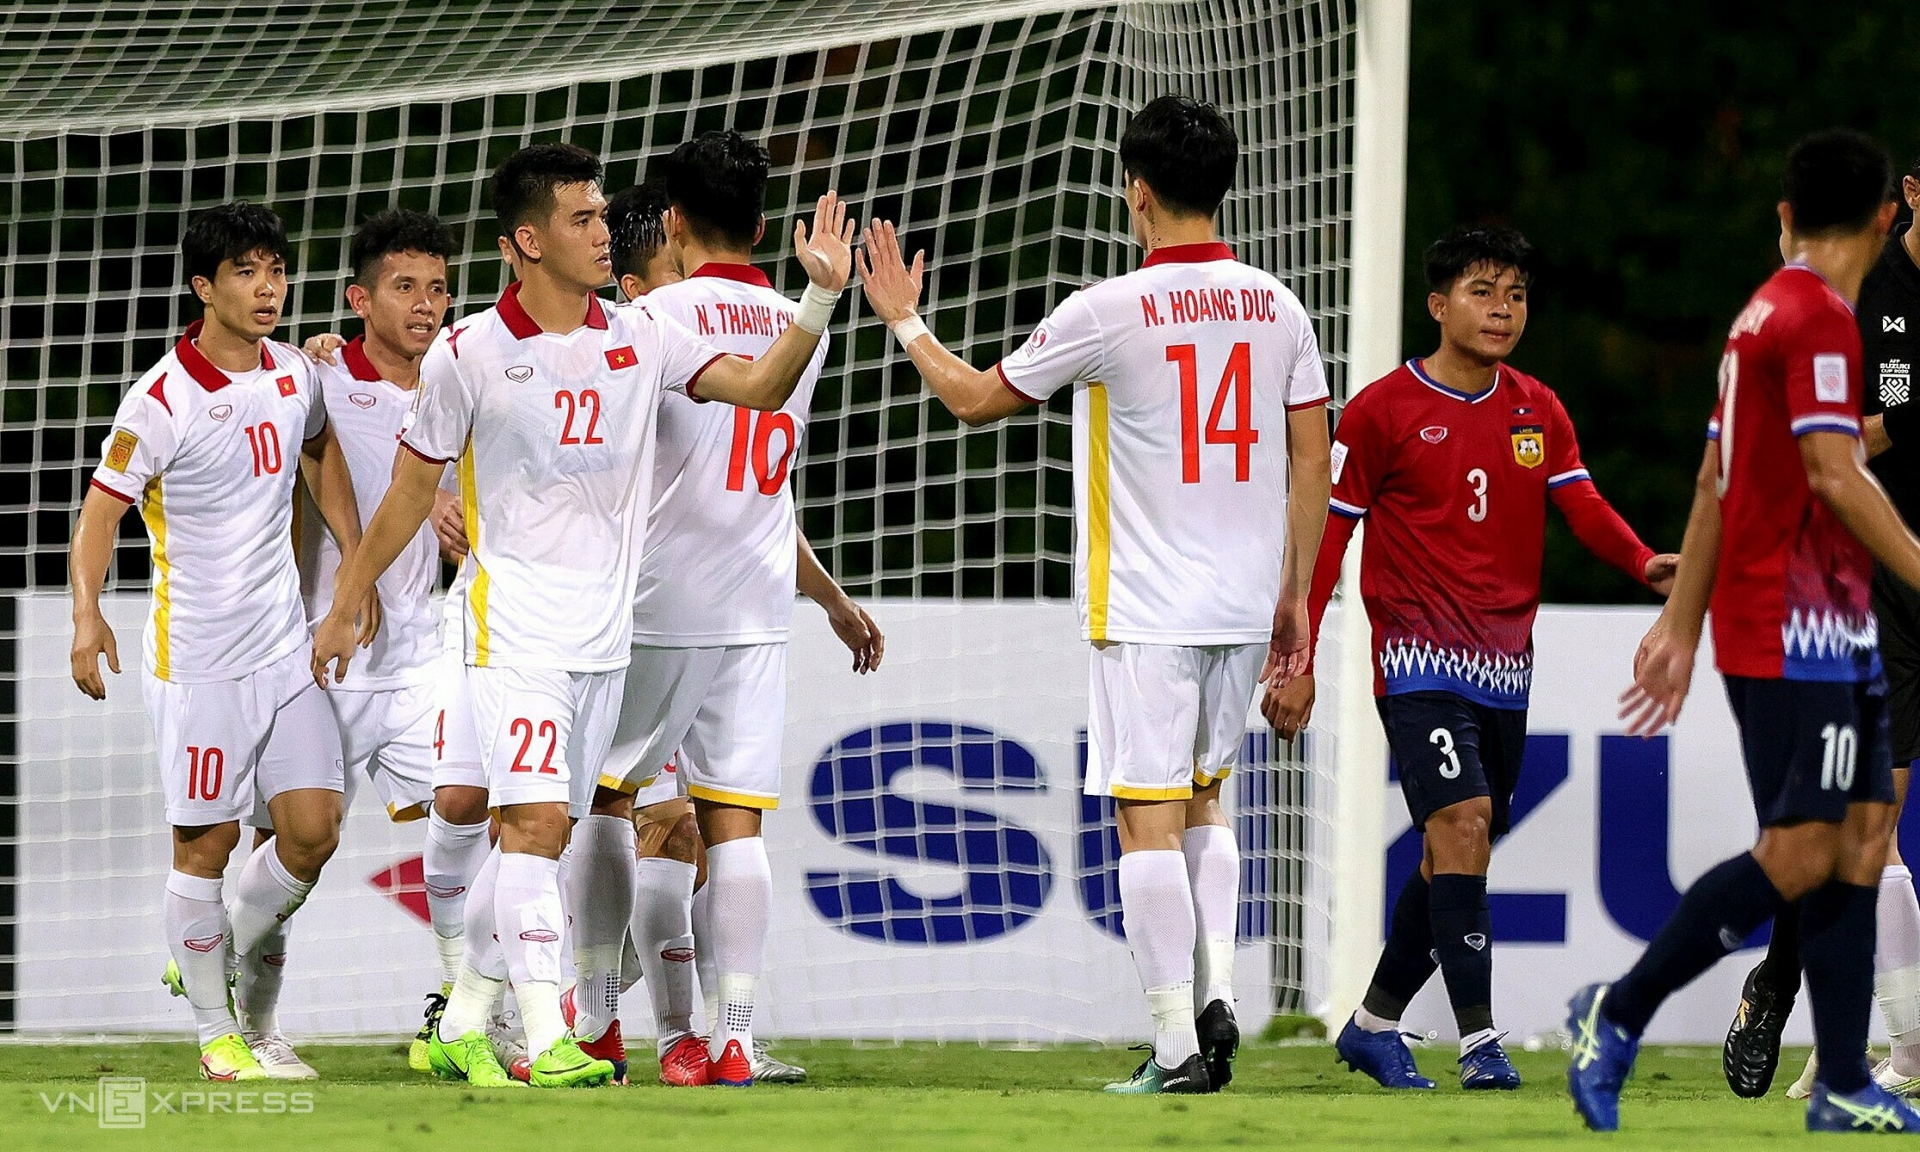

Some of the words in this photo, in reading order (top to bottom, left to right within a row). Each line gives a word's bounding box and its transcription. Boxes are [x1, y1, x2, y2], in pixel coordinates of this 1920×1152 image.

[694, 303, 716, 336] N.
[716, 303, 774, 337] THANH
[1140, 293, 1165, 328] N.
[1168, 289, 1237, 324] HOANG
[1240, 289, 1276, 323] DUC
[555, 389, 604, 446] 22
[726, 354, 795, 496] 16
[1165, 342, 1260, 485] 14
[244, 421, 283, 478] 10
[1467, 468, 1489, 524] 3
[186, 746, 224, 801] 10
[509, 717, 559, 775] 22
[1428, 727, 1462, 780] 3
[1820, 721, 1857, 791] 10
